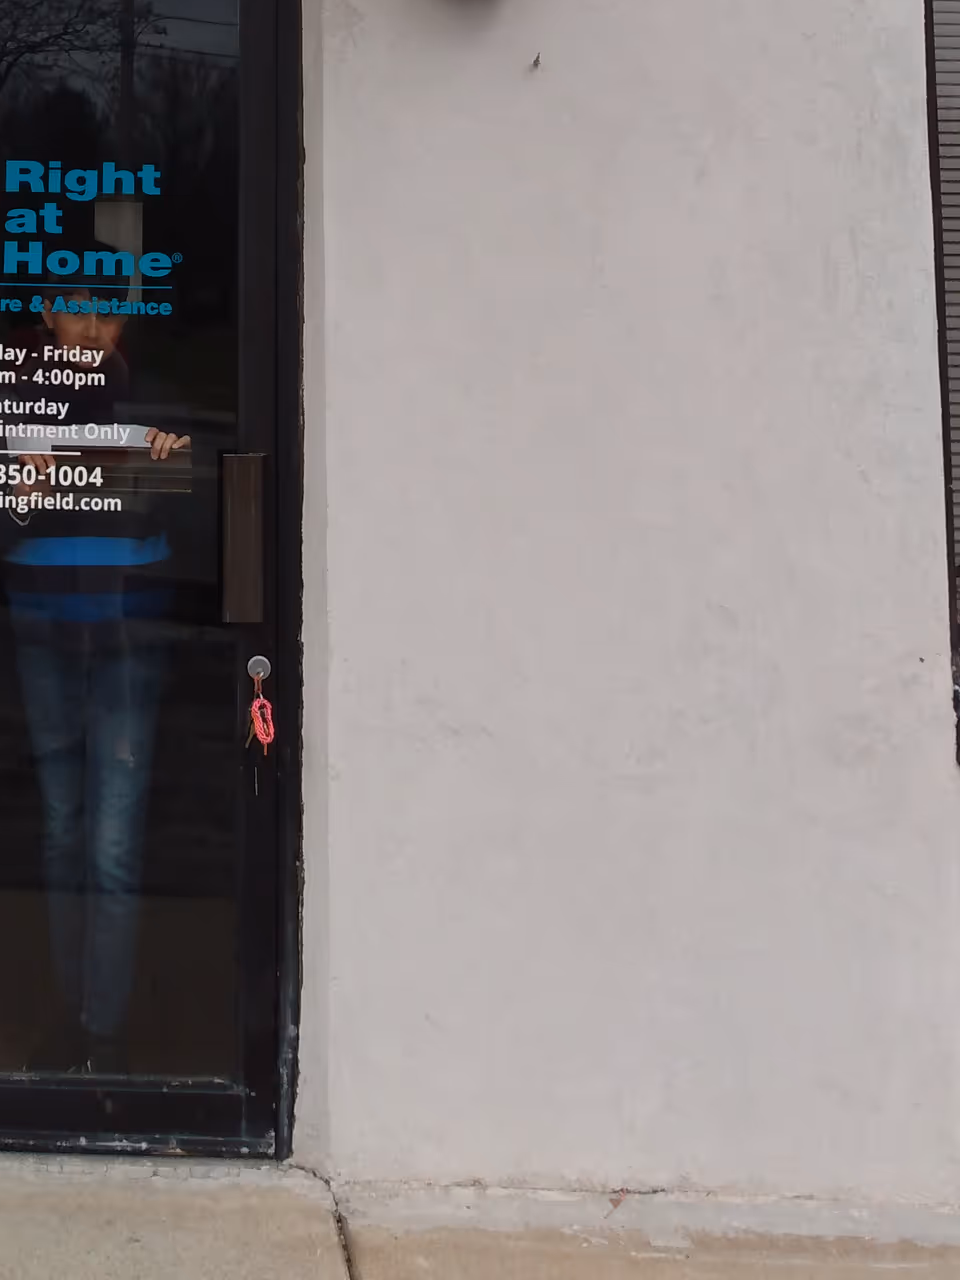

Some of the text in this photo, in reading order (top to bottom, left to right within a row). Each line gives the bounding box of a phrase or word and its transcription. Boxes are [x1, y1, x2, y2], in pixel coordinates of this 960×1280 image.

[5, 160, 161, 201] Right
[5, 203, 63, 234] at
[29, 296, 45, 313] &
[52, 296, 172, 316] Assistance
[43, 346, 104, 366] Friday
[33, 369, 106, 389] 4:00pm
[84, 423, 130, 445] Only
